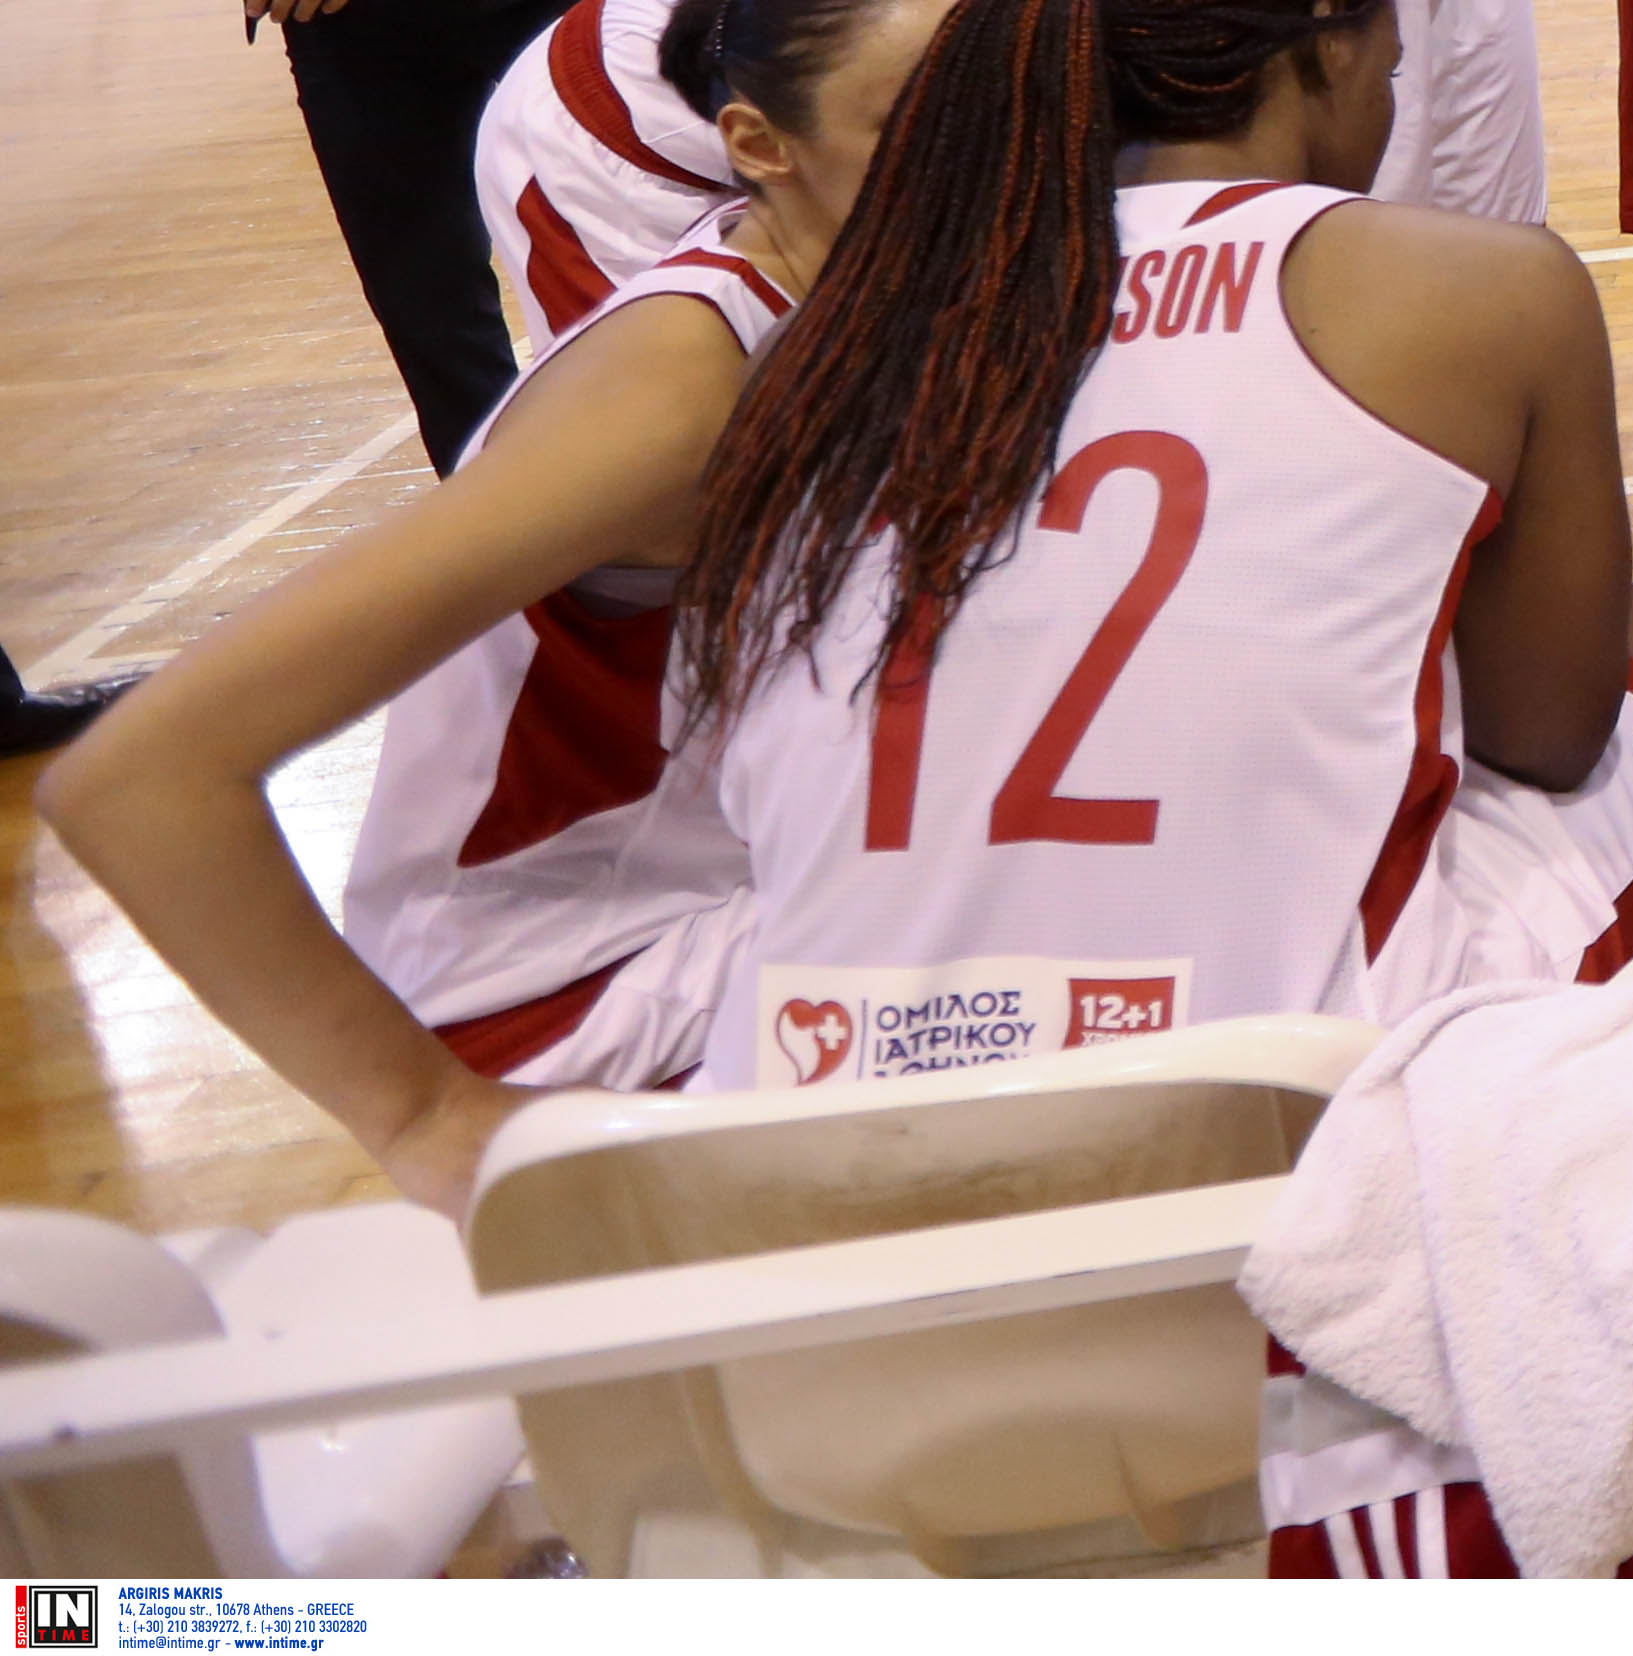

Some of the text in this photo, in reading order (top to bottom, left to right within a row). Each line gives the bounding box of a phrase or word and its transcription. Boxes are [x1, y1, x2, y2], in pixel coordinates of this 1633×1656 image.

[877, 991, 1021, 1032] ΟΜΙΛΟΣ
[1080, 995, 1164, 1029] 12+1
[876, 1023, 1037, 1065] ΙΑΤΡΙΚΟΥ
